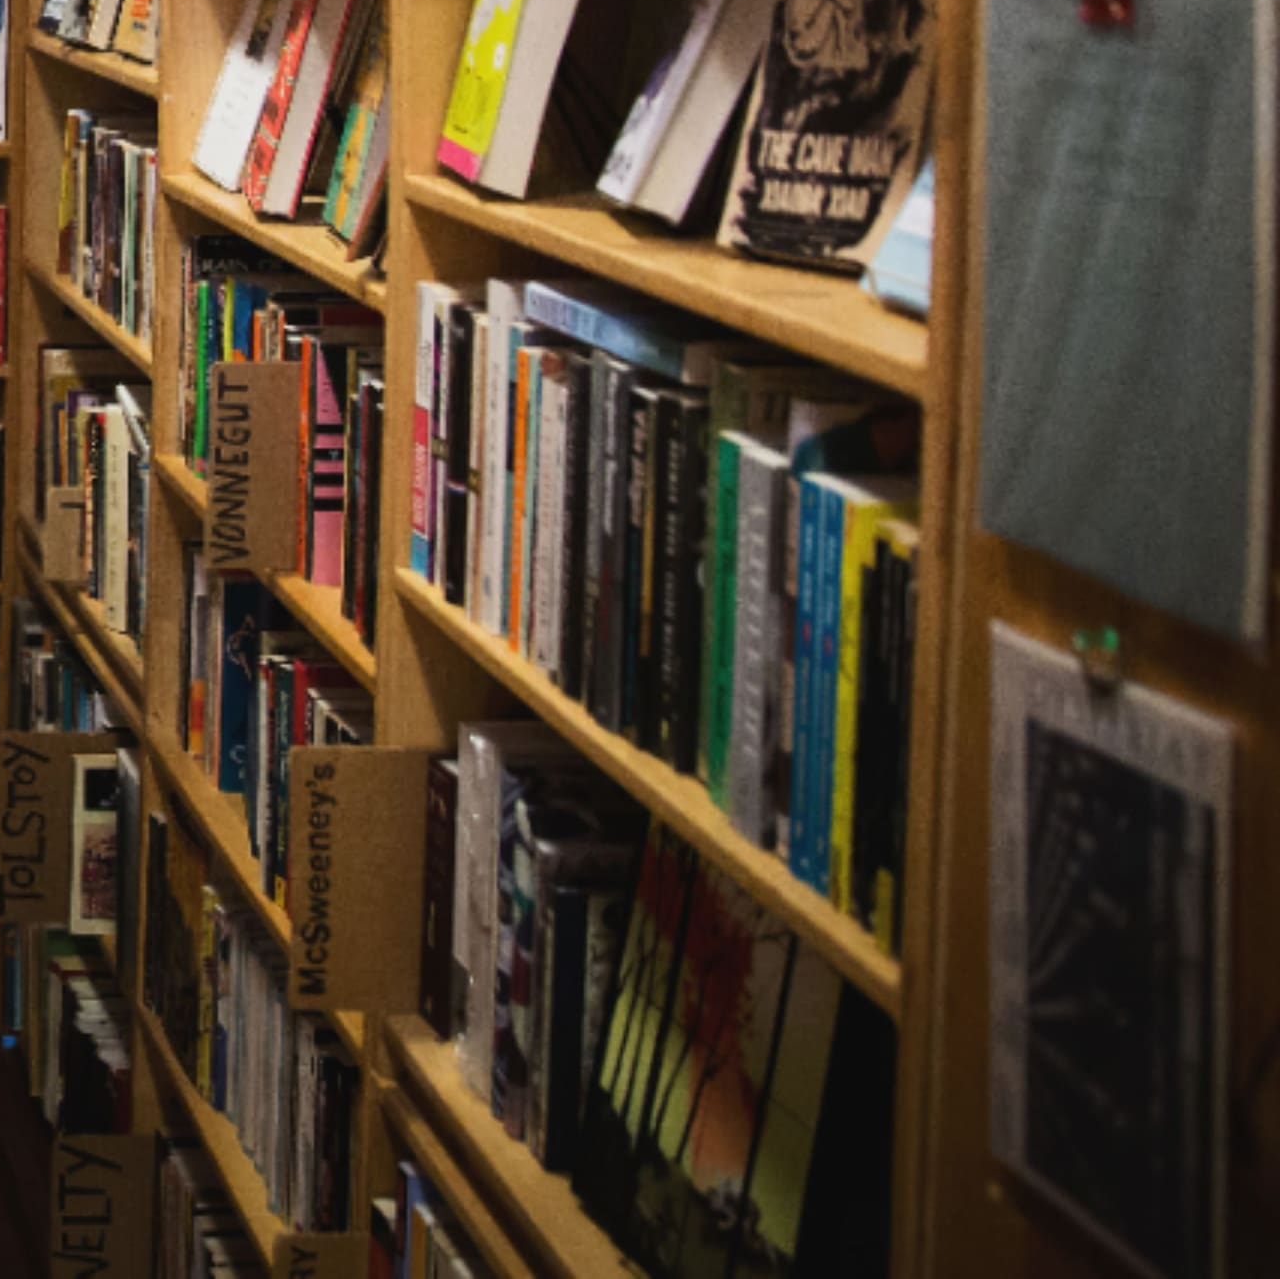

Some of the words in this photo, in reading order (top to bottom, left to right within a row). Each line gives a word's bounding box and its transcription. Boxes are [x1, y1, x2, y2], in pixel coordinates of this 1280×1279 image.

[757, 128, 797, 170] THE
[794, 132, 846, 174] CAVE
[209, 369, 252, 568] VONNEGUT
[296, 761, 335, 997] McSweeney's
